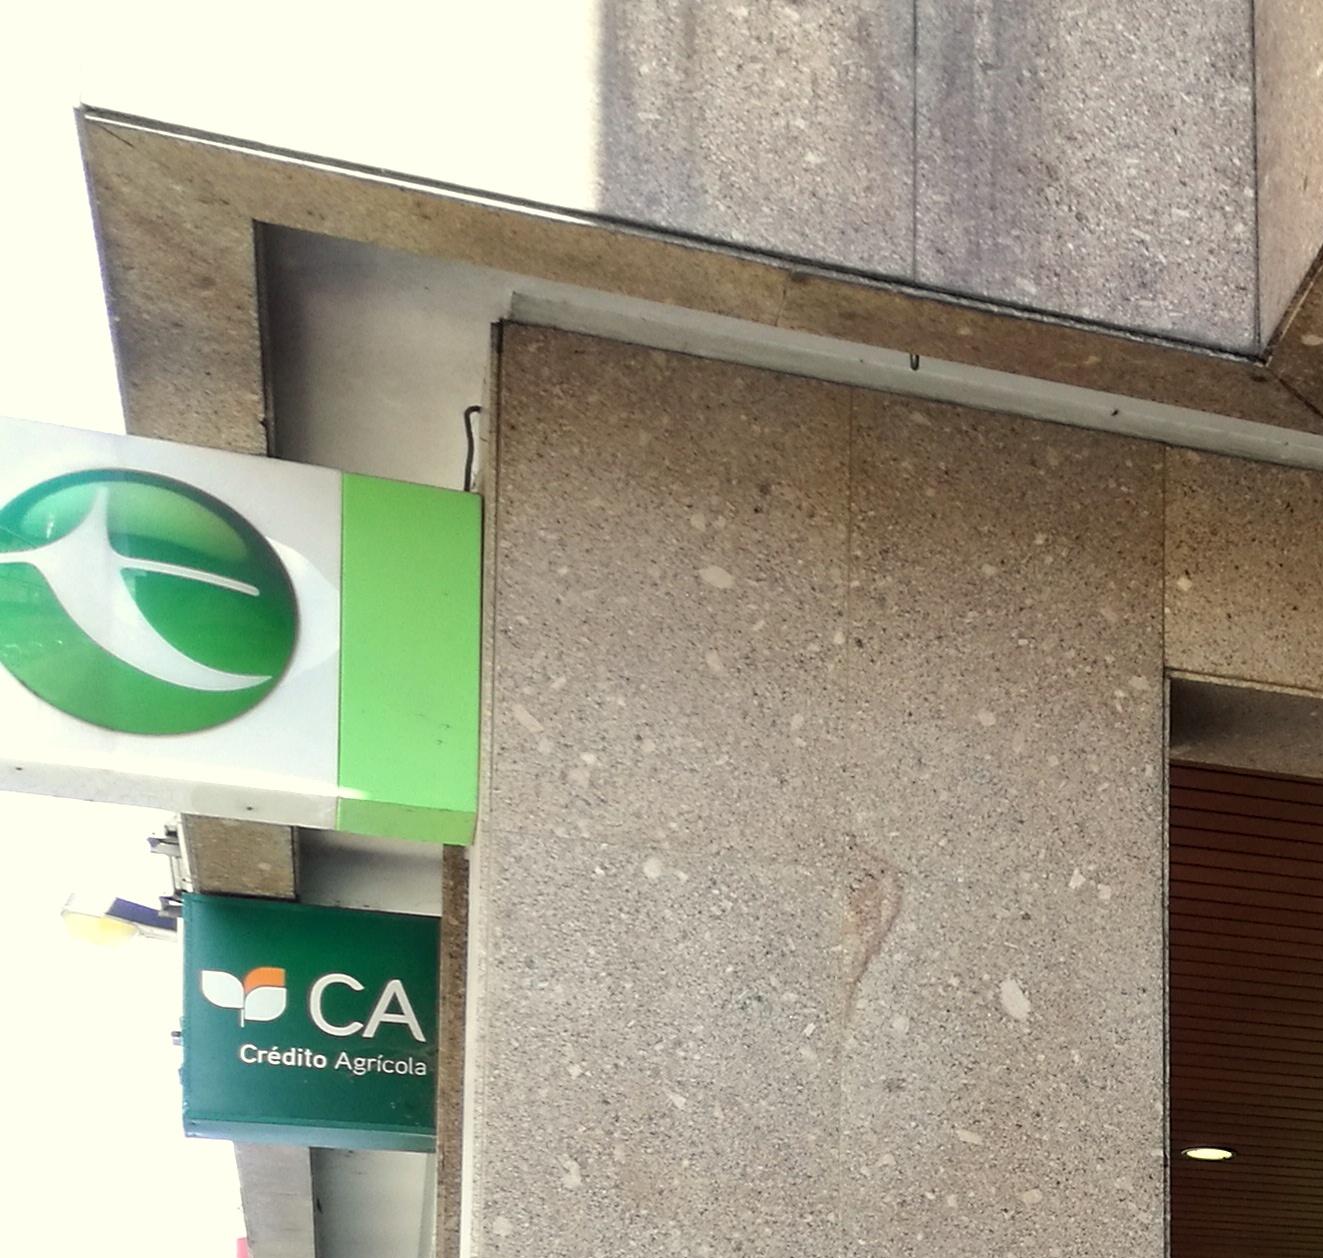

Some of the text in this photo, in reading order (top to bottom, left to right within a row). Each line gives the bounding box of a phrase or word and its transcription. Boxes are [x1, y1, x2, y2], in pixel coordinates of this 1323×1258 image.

[309, 973, 427, 1042] CA
[240, 1043, 427, 1076] Crédito Agrícola
